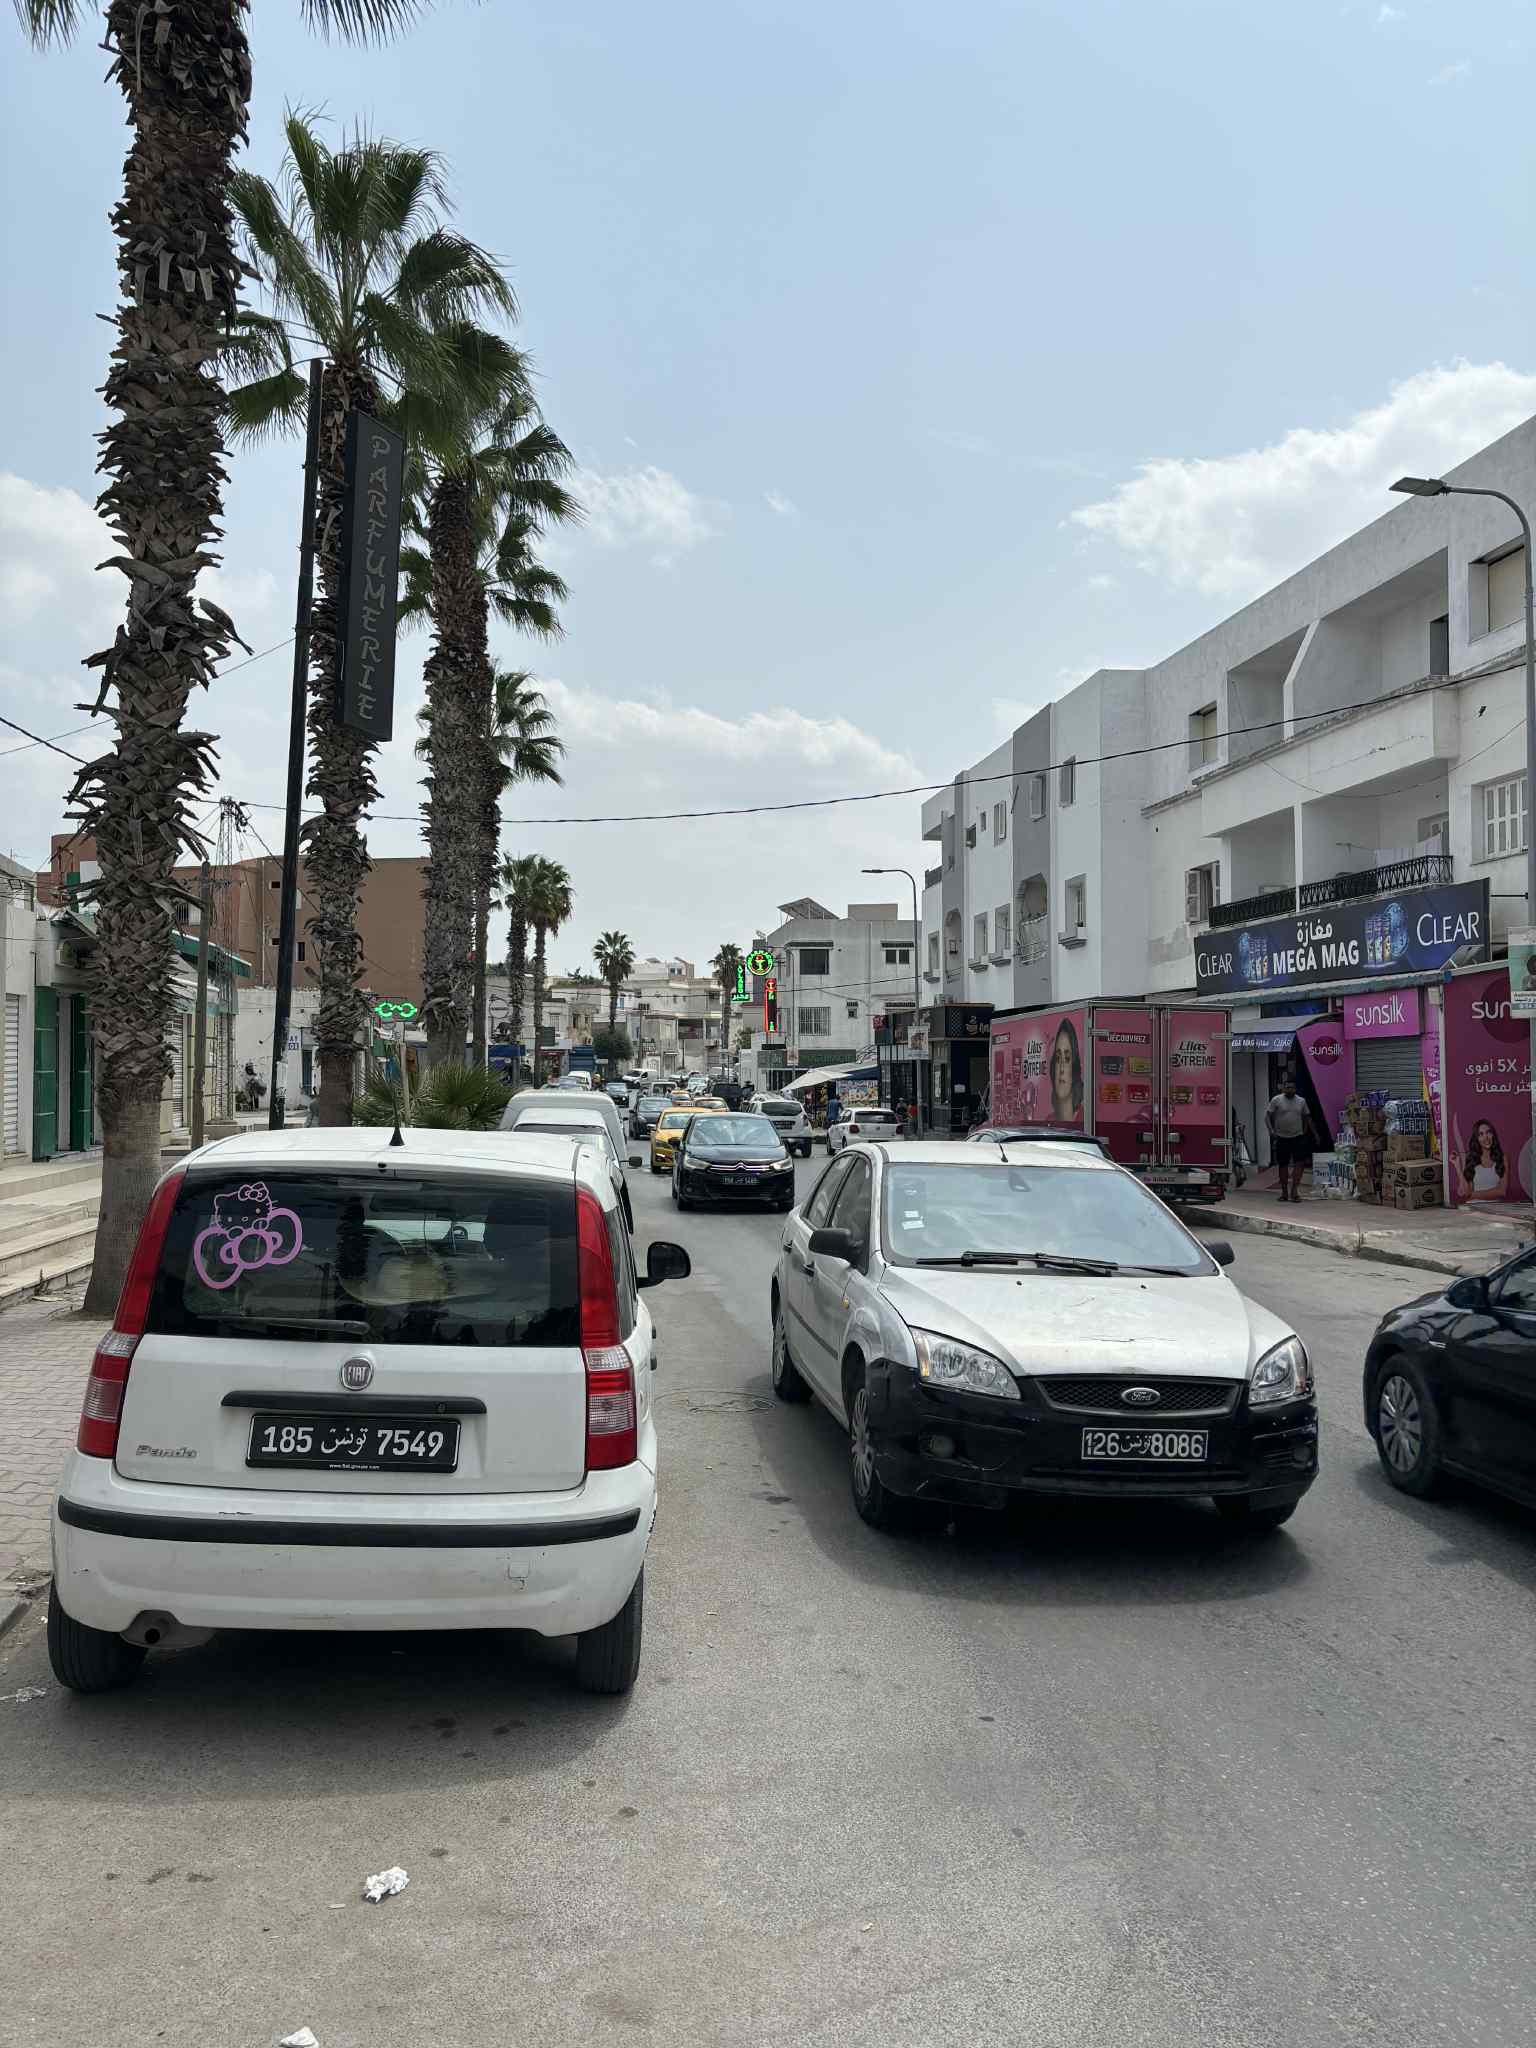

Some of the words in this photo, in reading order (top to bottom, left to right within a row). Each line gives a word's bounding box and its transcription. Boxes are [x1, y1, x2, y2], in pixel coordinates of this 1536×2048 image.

[357, 435, 391, 720] PARFUMERIE
[1296, 918, 1333, 947] مغازة
[1417, 911, 1480, 946] CLEAR
[1197, 953, 1233, 978] CLEAR
[1273, 945, 1318, 976] MEGA
[1321, 940, 1360, 969] MAG
[1355, 993, 1406, 1028] sunsilk
[1471, 1001, 1512, 1020] sun
[1308, 1043, 1344, 1057] sunsilk
[1497, 1058, 1518, 1073] 5X
[348, 1366, 367, 1382] FIAT
[135, 1444, 198, 1459] Panda
[261, 1425, 314, 1453] 185
[320, 1426, 369, 1455] تونس
[376, 1429, 444, 1458] 7549
[1085, 1432, 1120, 1456] 126
[1120, 1434, 1151, 1455] تونس
[1150, 1433, 1204, 1457] 8086
